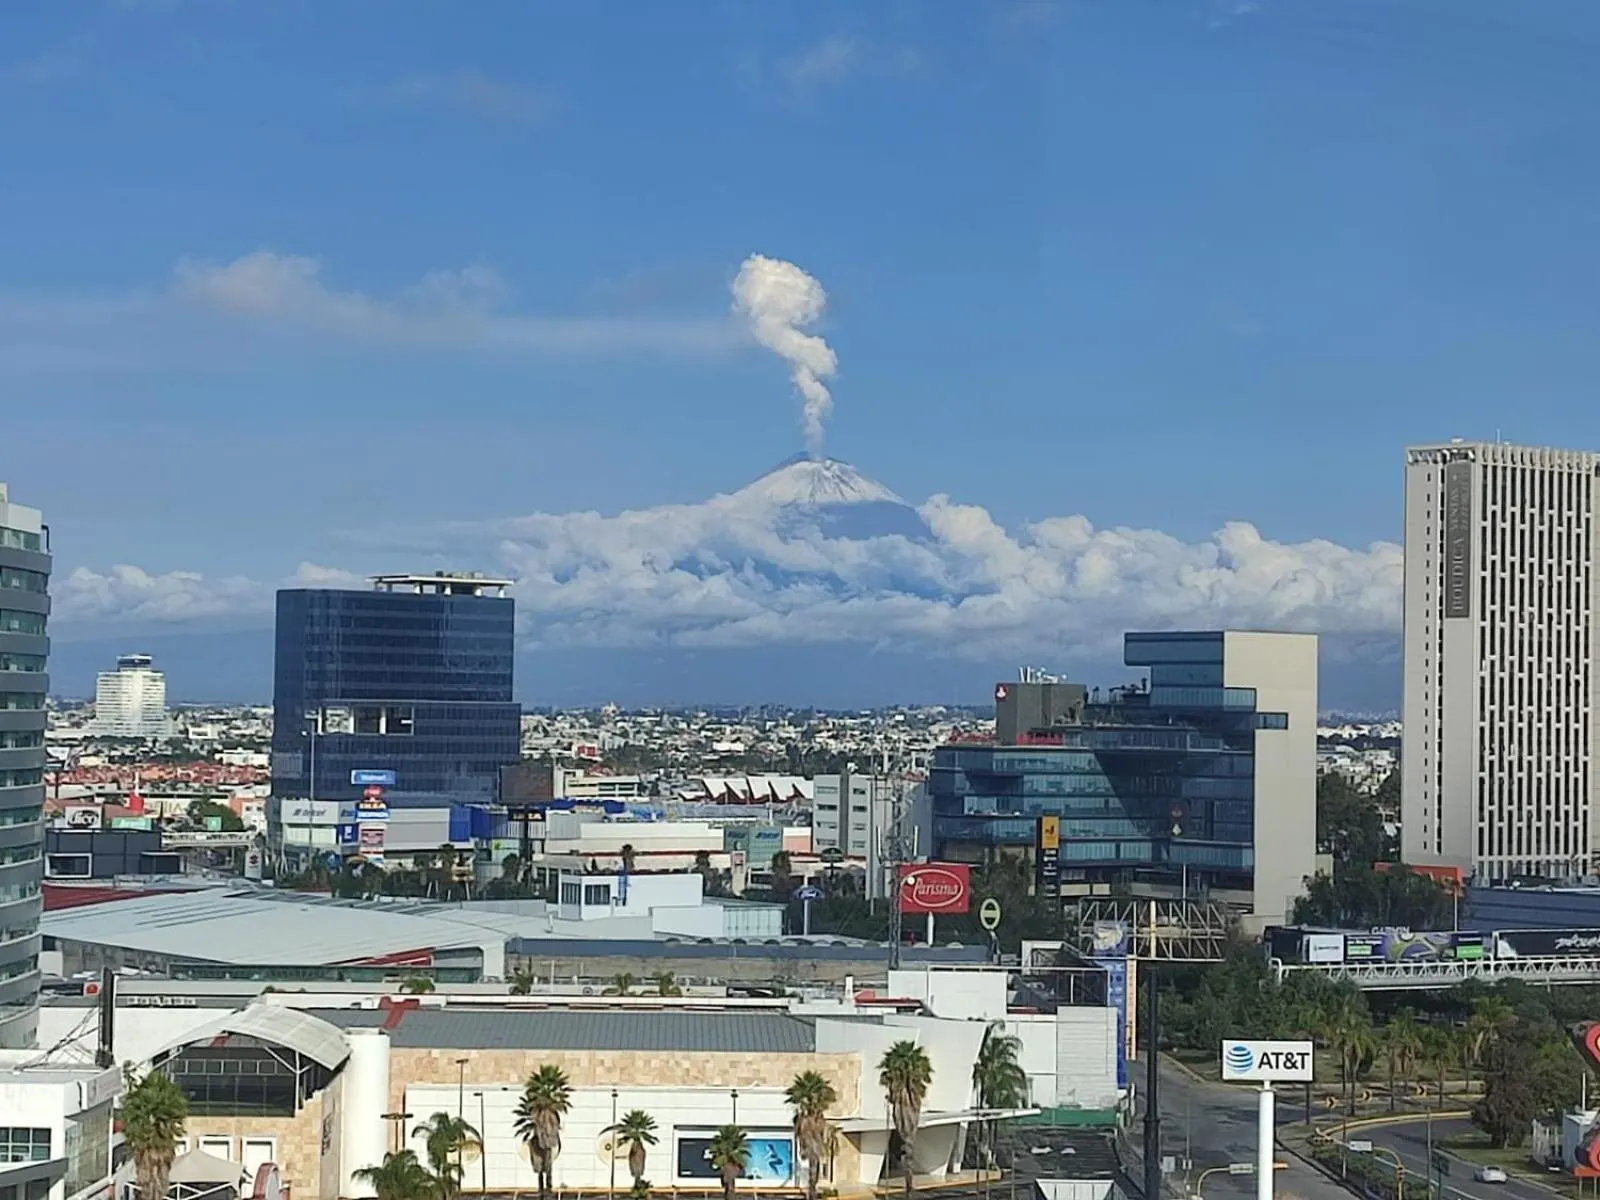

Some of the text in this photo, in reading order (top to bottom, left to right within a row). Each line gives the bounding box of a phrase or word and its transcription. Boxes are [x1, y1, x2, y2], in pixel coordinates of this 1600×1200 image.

[1451, 537, 1465, 611] BOUDICA
[914, 876, 959, 896] Parisina
[1258, 1051, 1310, 1070] AT&T
